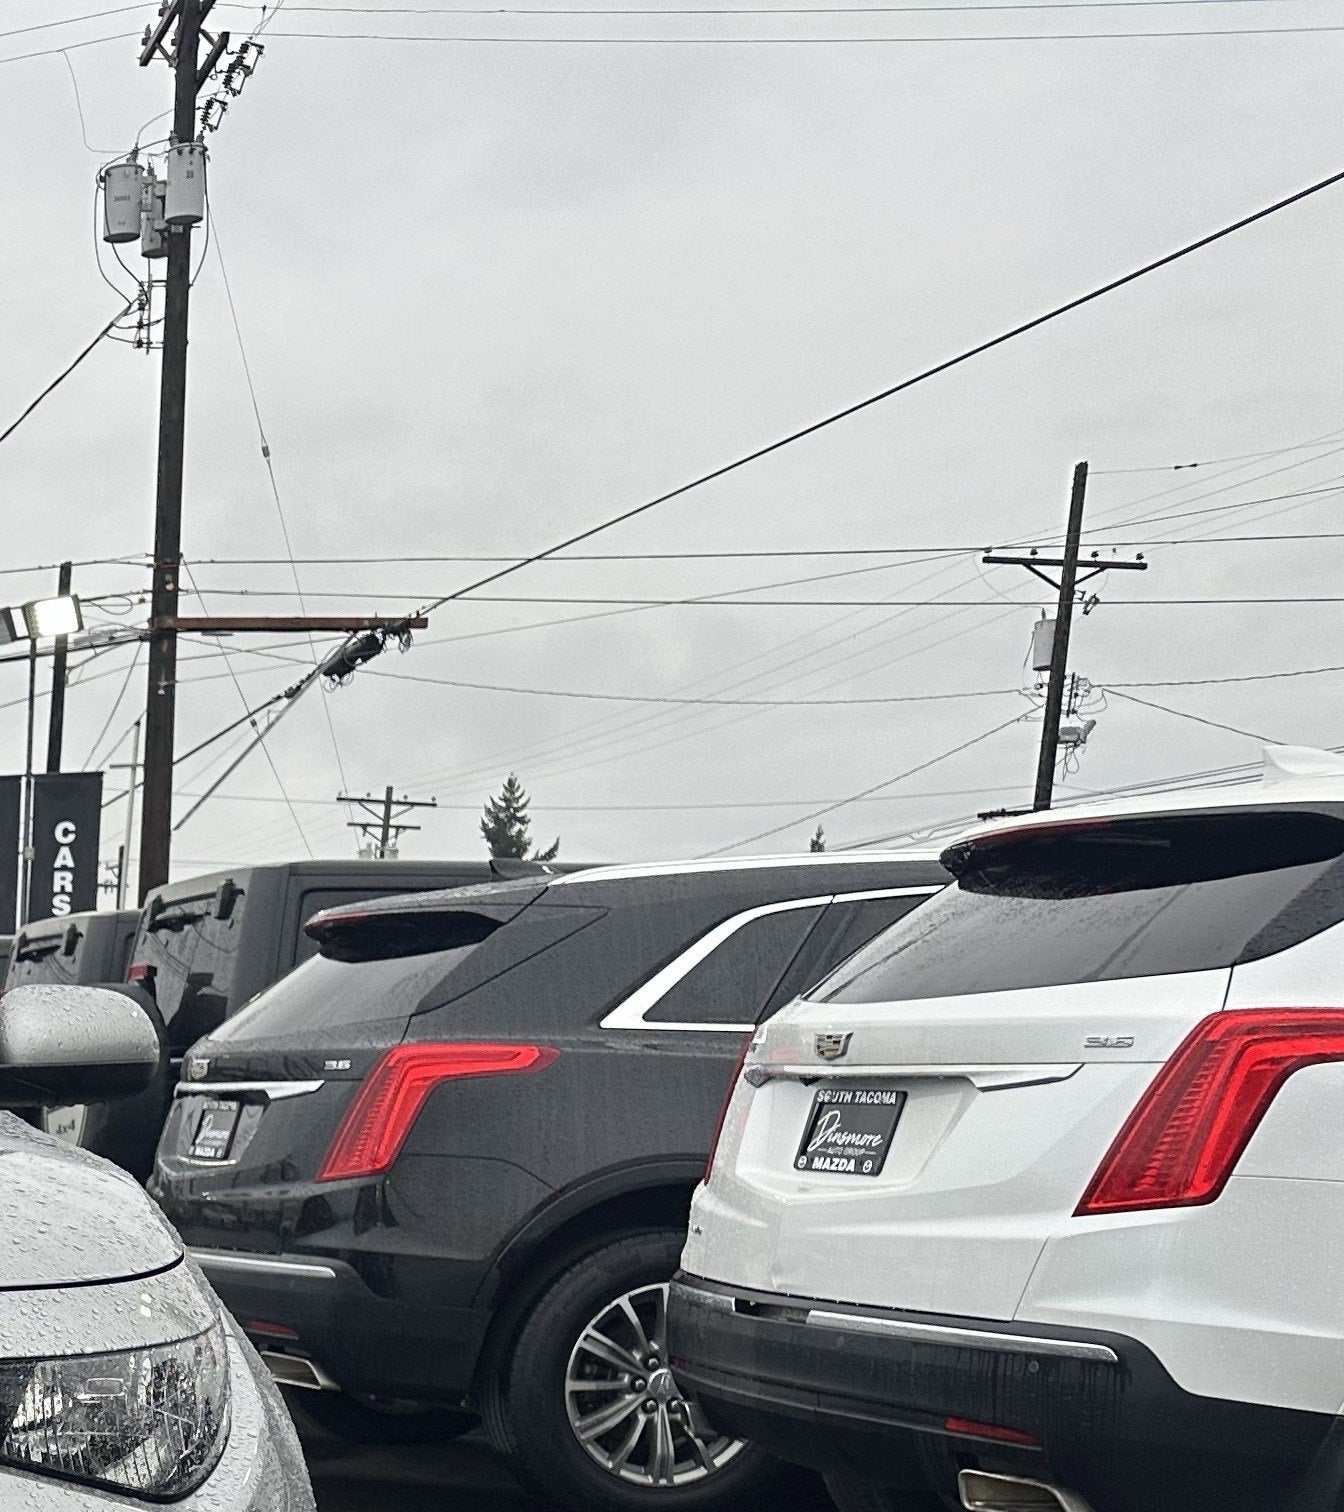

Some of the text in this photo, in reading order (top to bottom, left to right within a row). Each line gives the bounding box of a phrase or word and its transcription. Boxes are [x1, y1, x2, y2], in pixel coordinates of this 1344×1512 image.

[51, 820, 76, 917] CARS
[807, 1110, 883, 1152] Dinsmore
[812, 1156, 855, 1172] MAZDA
